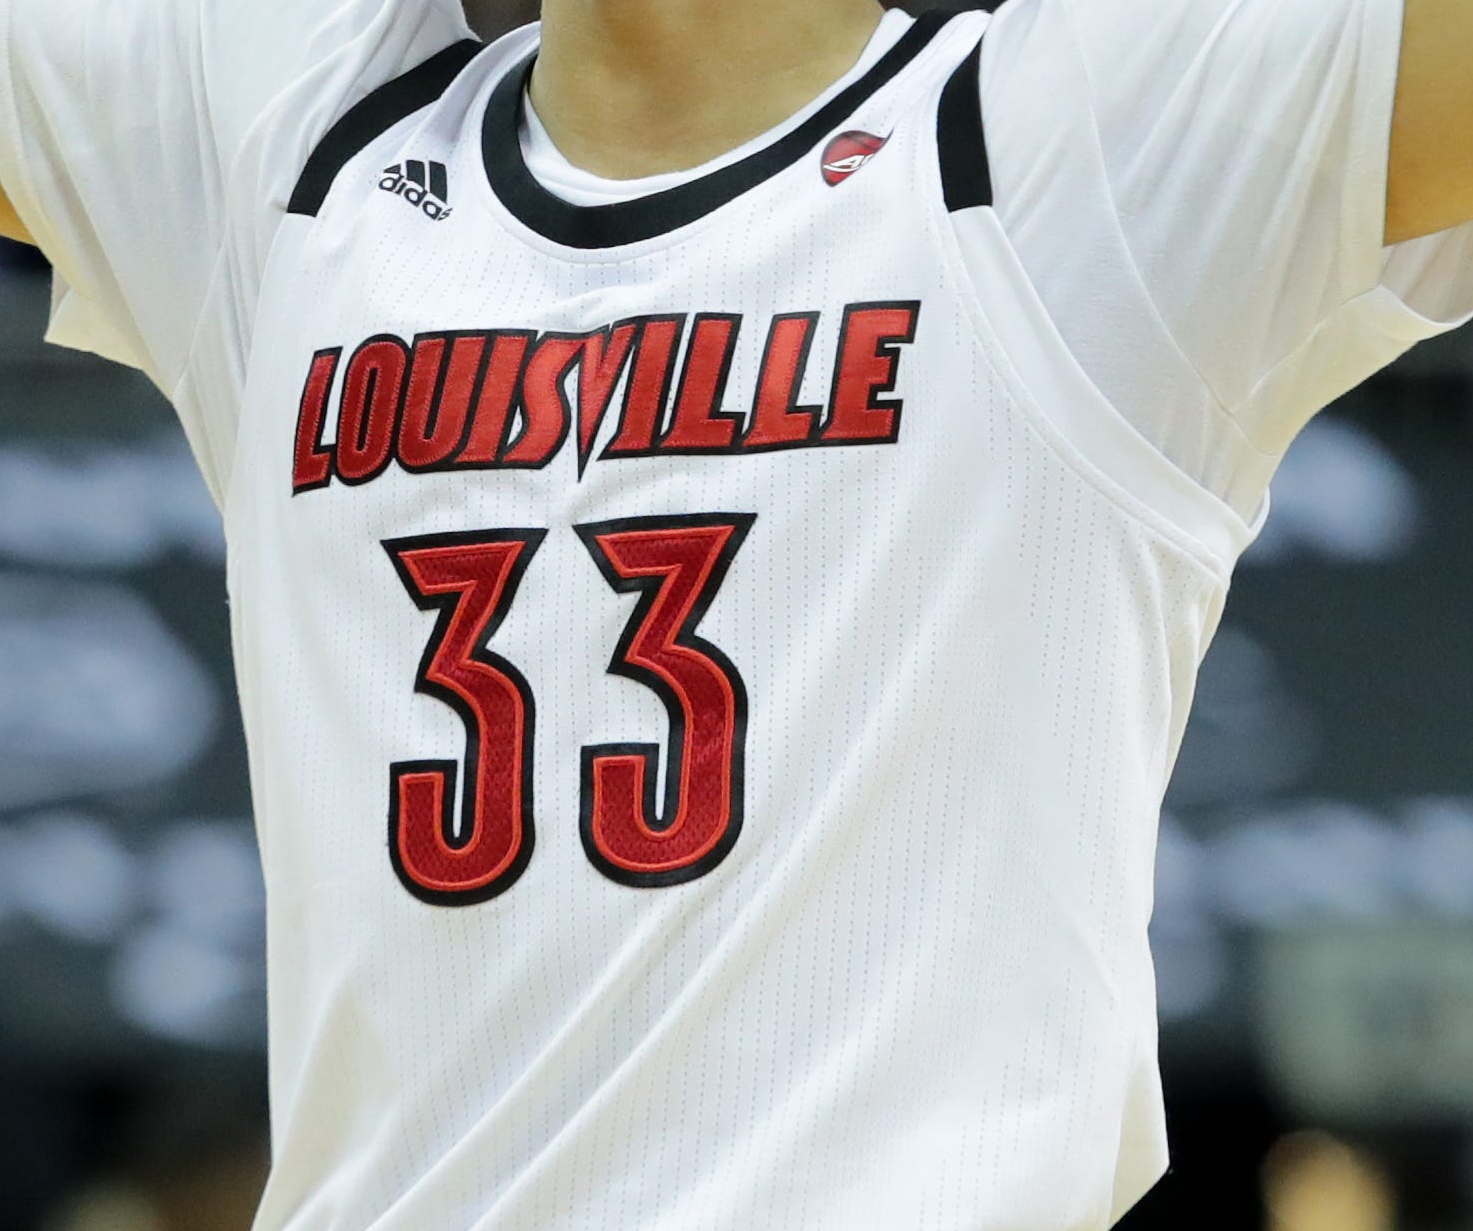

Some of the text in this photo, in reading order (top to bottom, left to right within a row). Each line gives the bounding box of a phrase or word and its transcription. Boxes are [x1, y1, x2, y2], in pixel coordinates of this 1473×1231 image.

[378, 173, 453, 221] adidas
[291, 299, 920, 496] LOUISVILLE
[380, 512, 758, 908] 33
